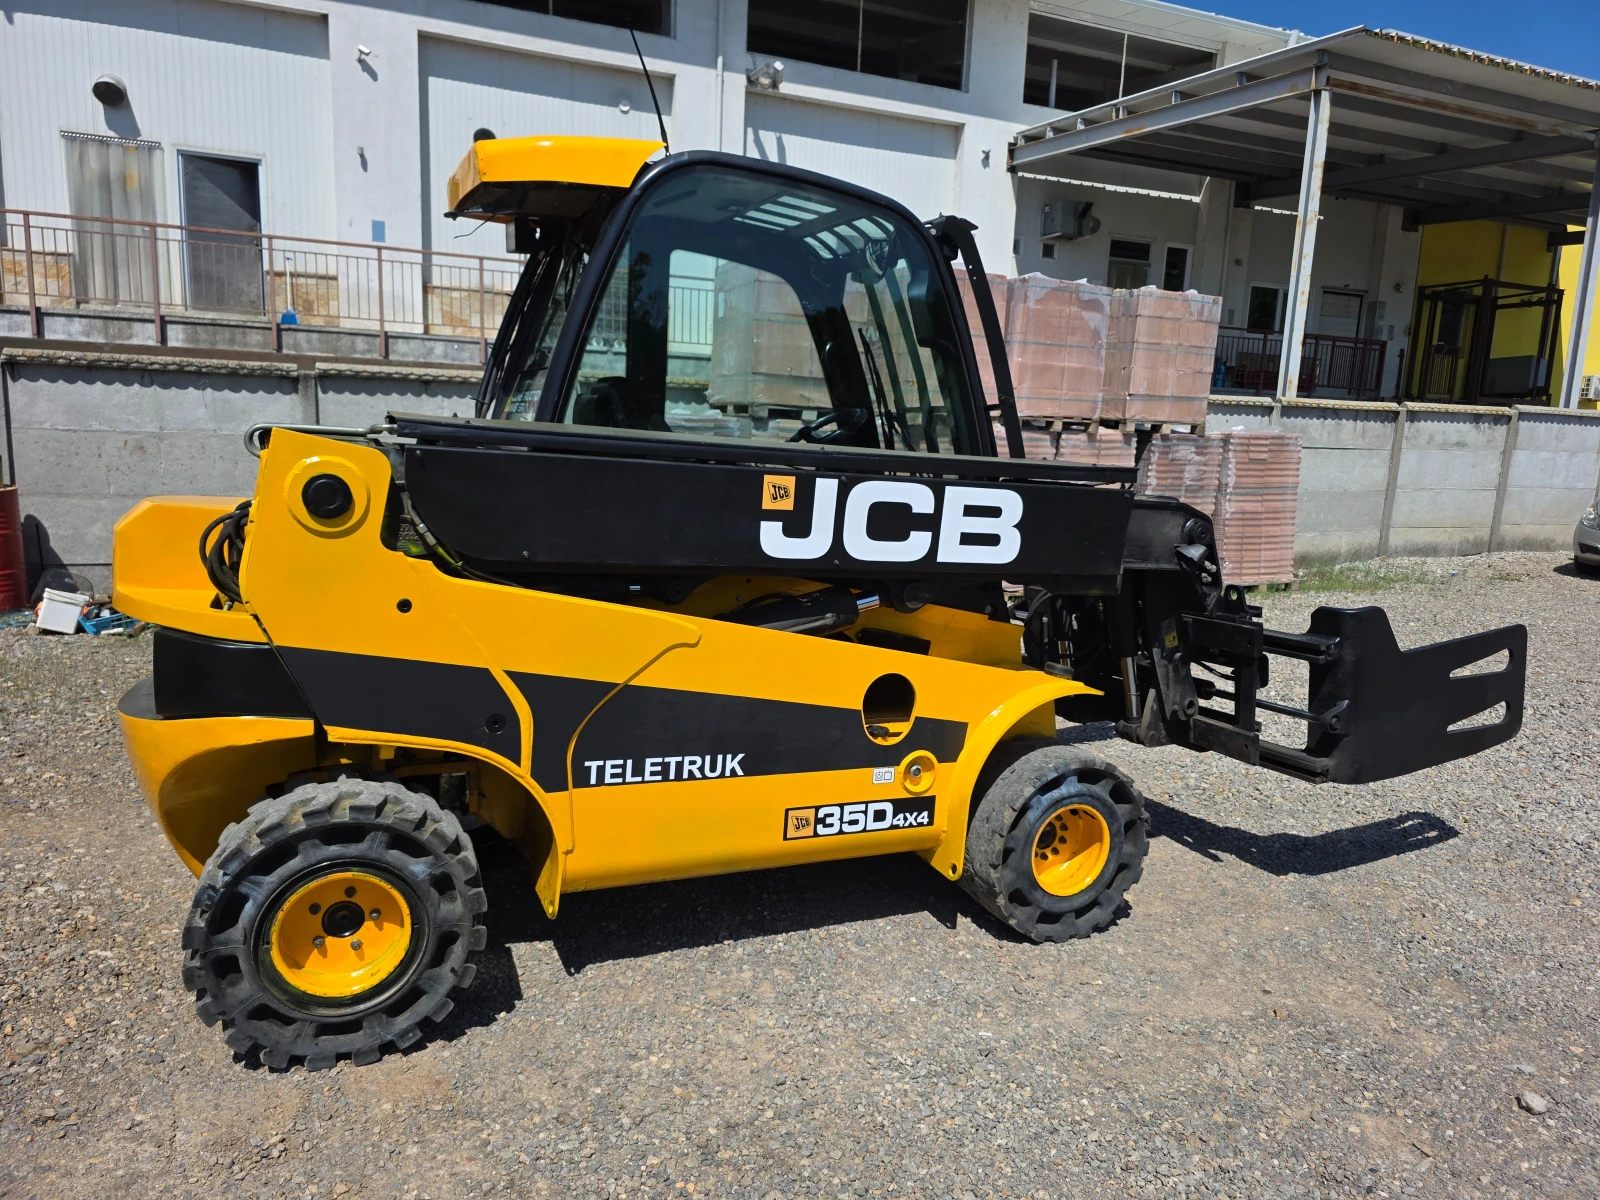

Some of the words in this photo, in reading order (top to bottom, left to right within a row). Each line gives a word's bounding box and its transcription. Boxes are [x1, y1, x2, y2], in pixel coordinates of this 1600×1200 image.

[771, 483, 790, 501] JCB
[760, 477, 1023, 564] JCB
[584, 753, 746, 785] TELETRUK
[794, 816, 811, 831] JCB
[816, 801, 894, 836] 35D
